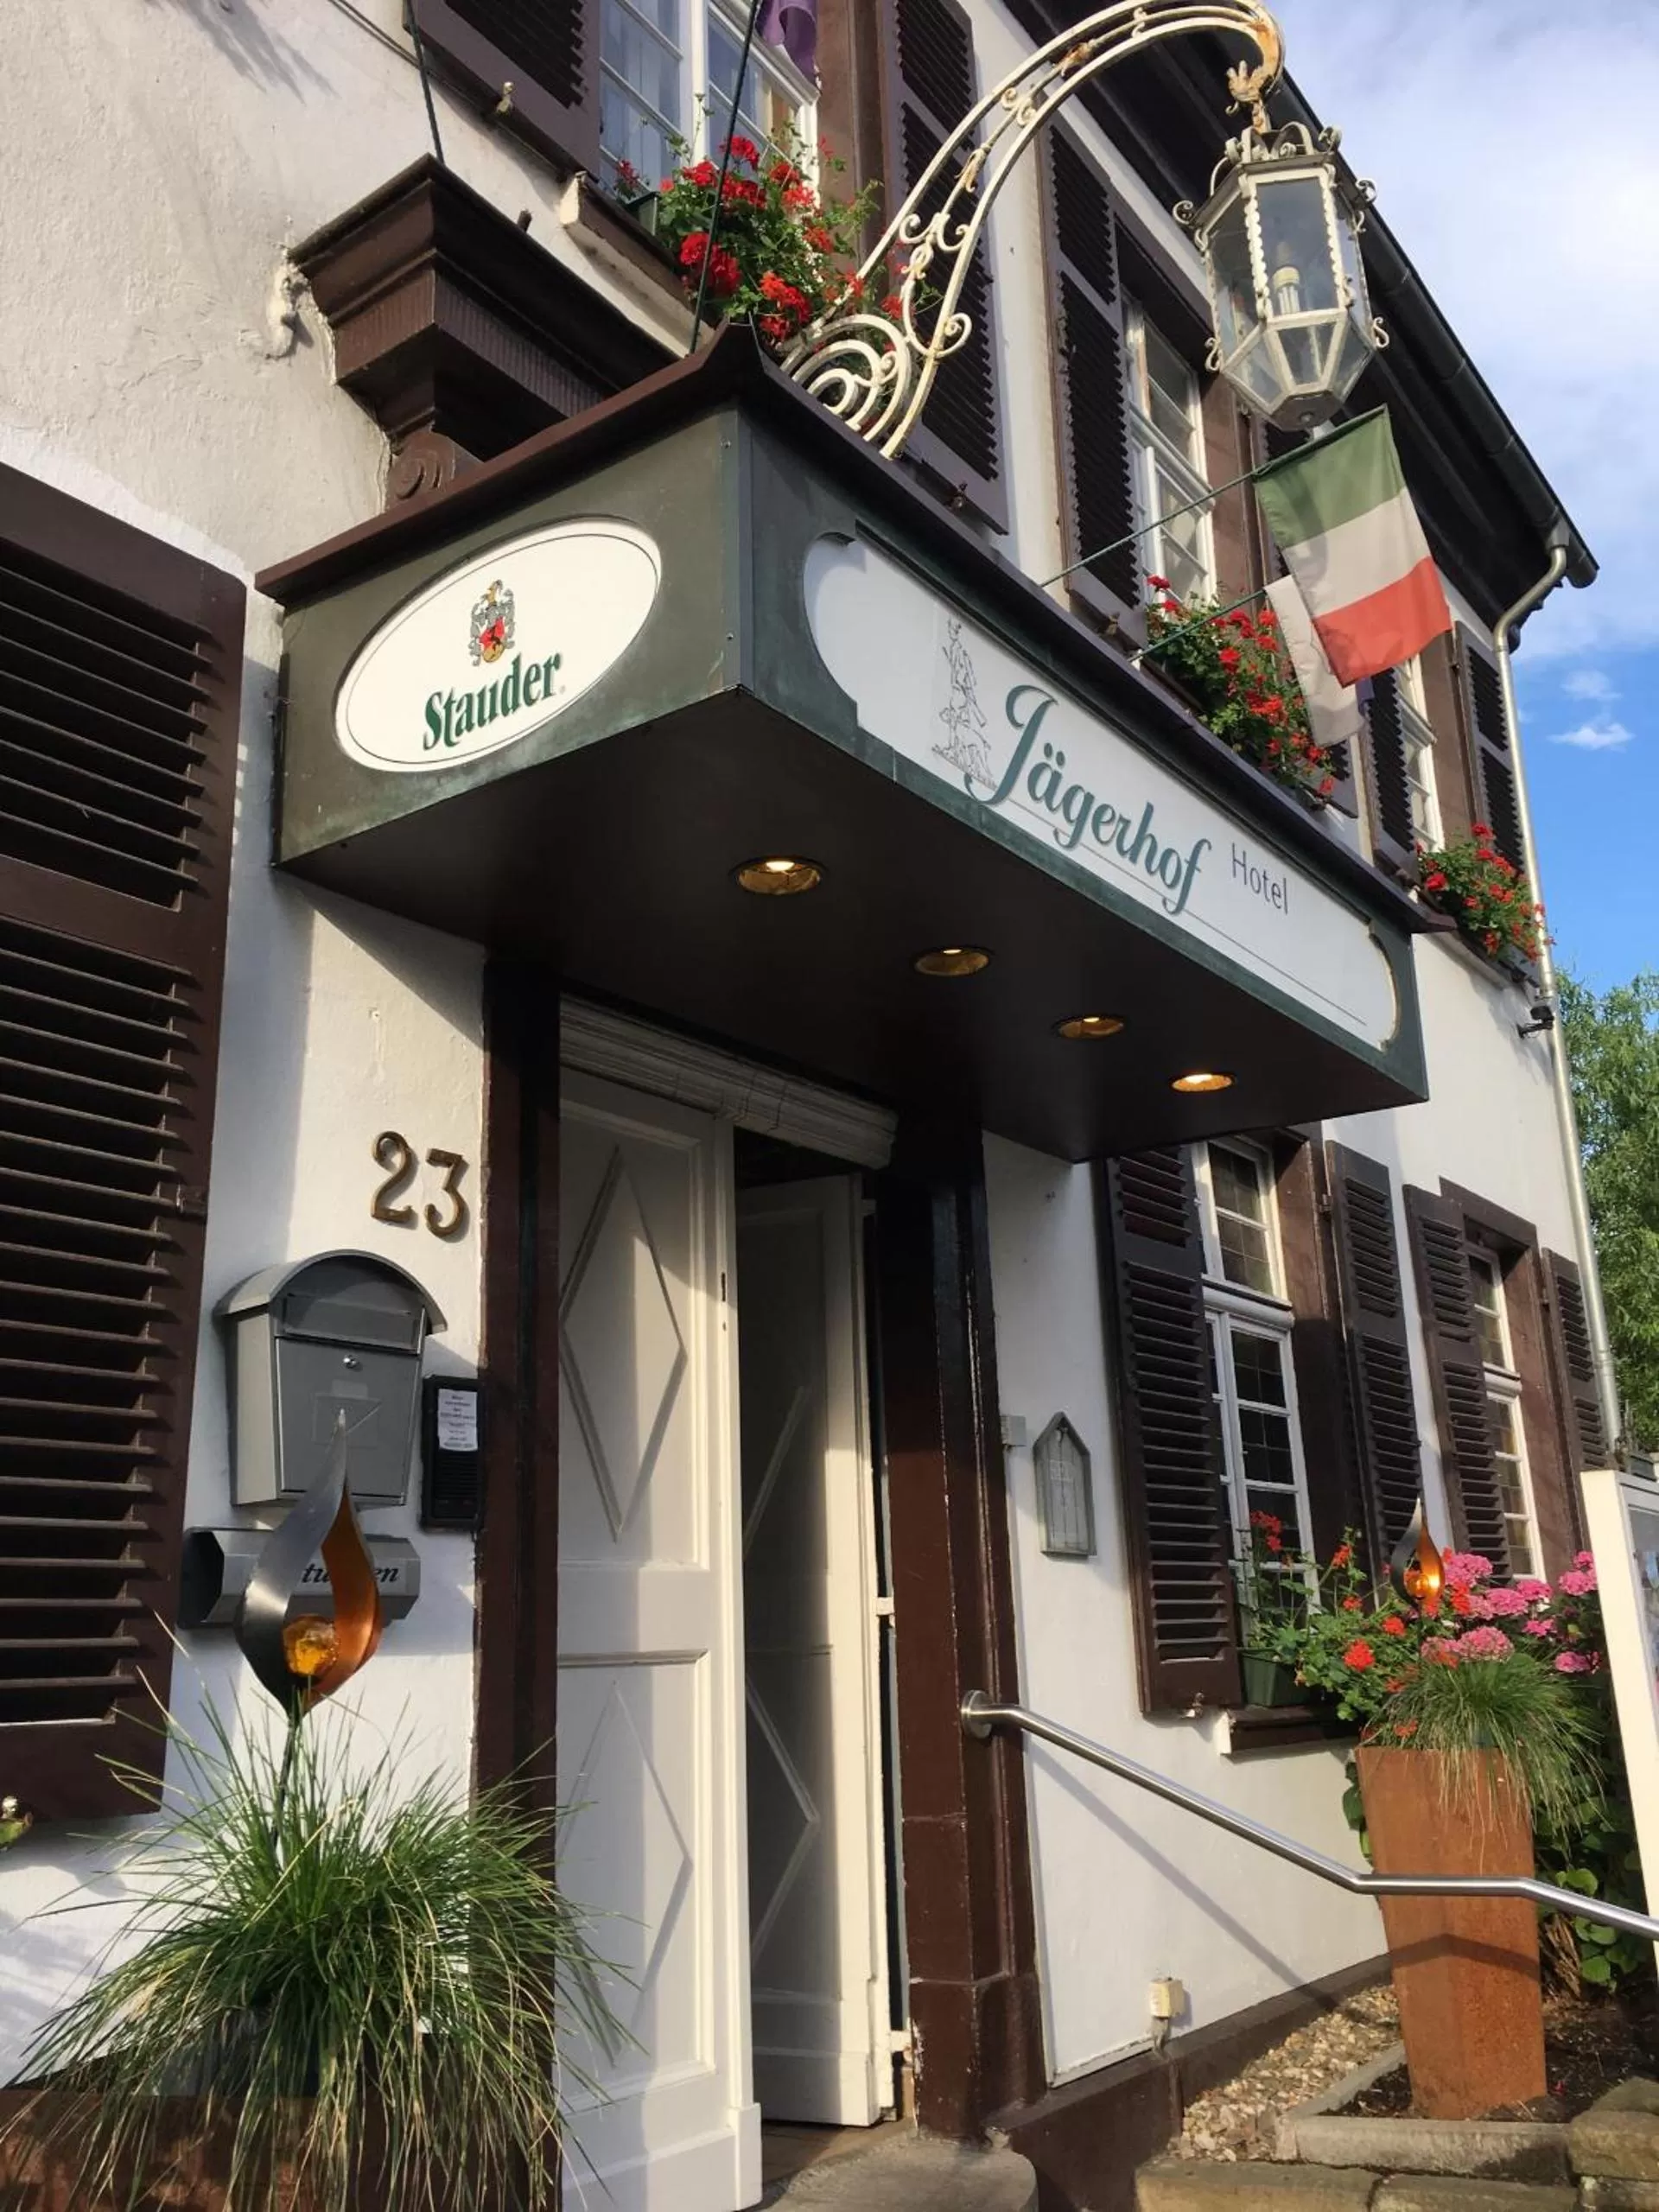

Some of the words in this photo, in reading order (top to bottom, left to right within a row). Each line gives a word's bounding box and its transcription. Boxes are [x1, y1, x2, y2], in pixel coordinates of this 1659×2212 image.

[423, 652, 563, 751] Stauder
[963, 684, 1212, 916] Jägerhof
[1231, 842, 1288, 916] Hotel
[371, 1130, 467, 1239] 23
